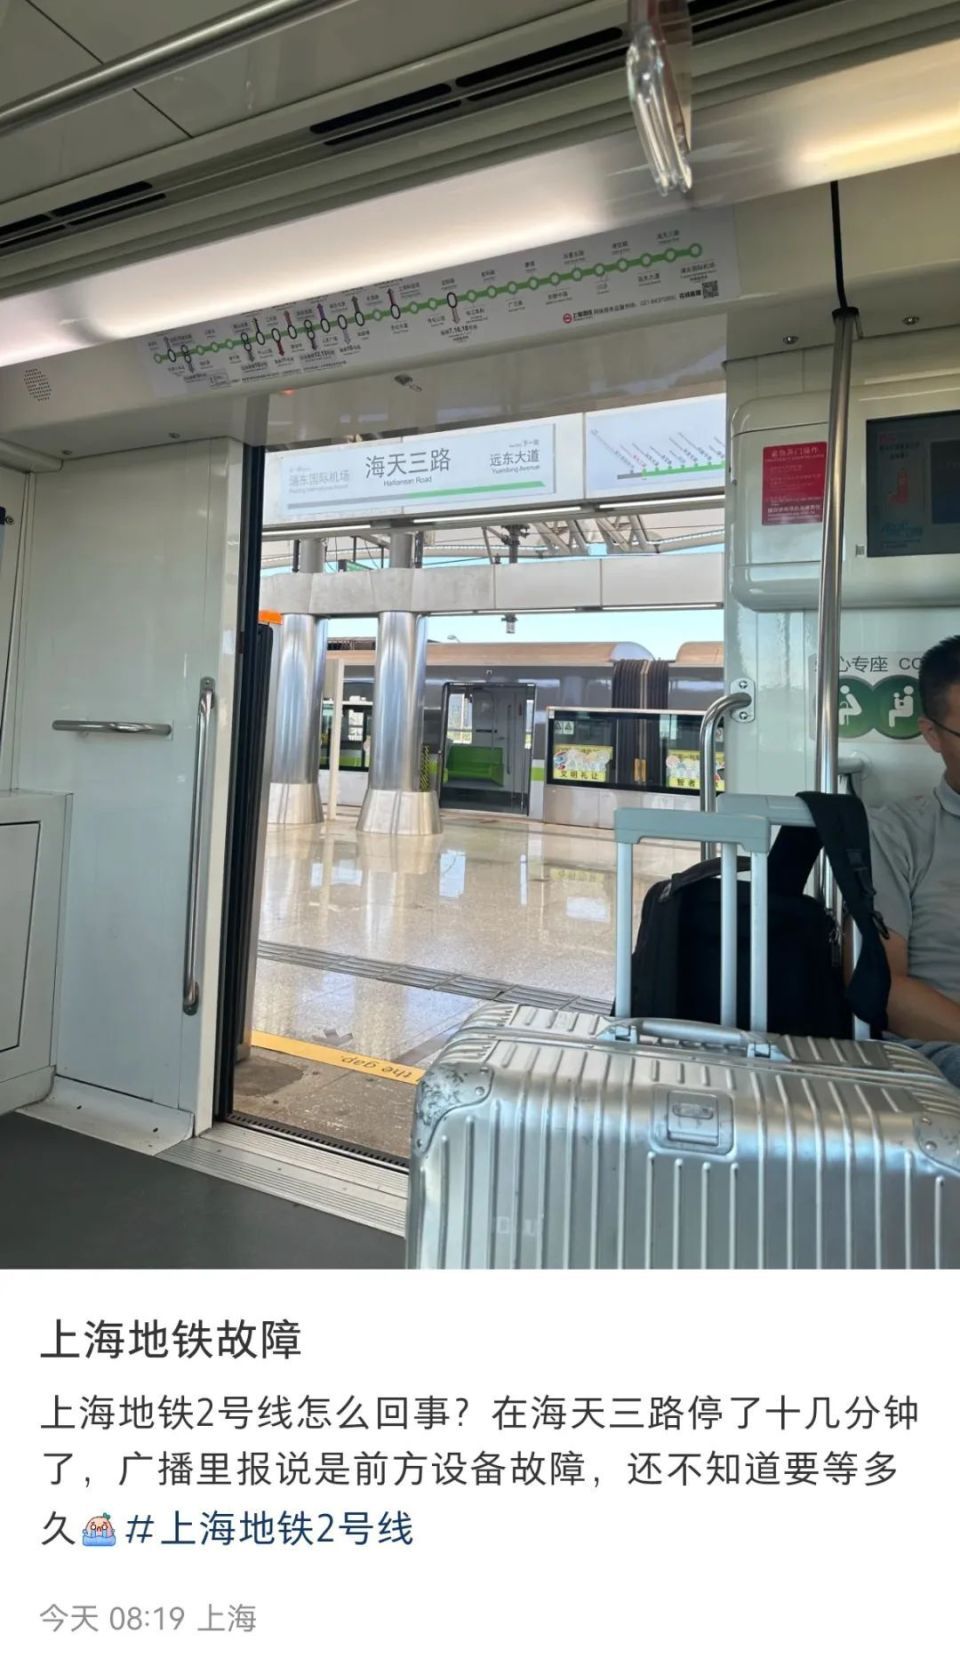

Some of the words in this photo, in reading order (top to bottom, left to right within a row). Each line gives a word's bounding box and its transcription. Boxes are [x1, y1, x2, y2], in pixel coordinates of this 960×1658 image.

[365, 448, 451, 479] 海天三路
[490, 449, 540, 467] 远东大道
[415, 475, 433, 484] Road
[559, 770, 599, 780] 文明礼让
[381, 1066, 413, 1078] the
